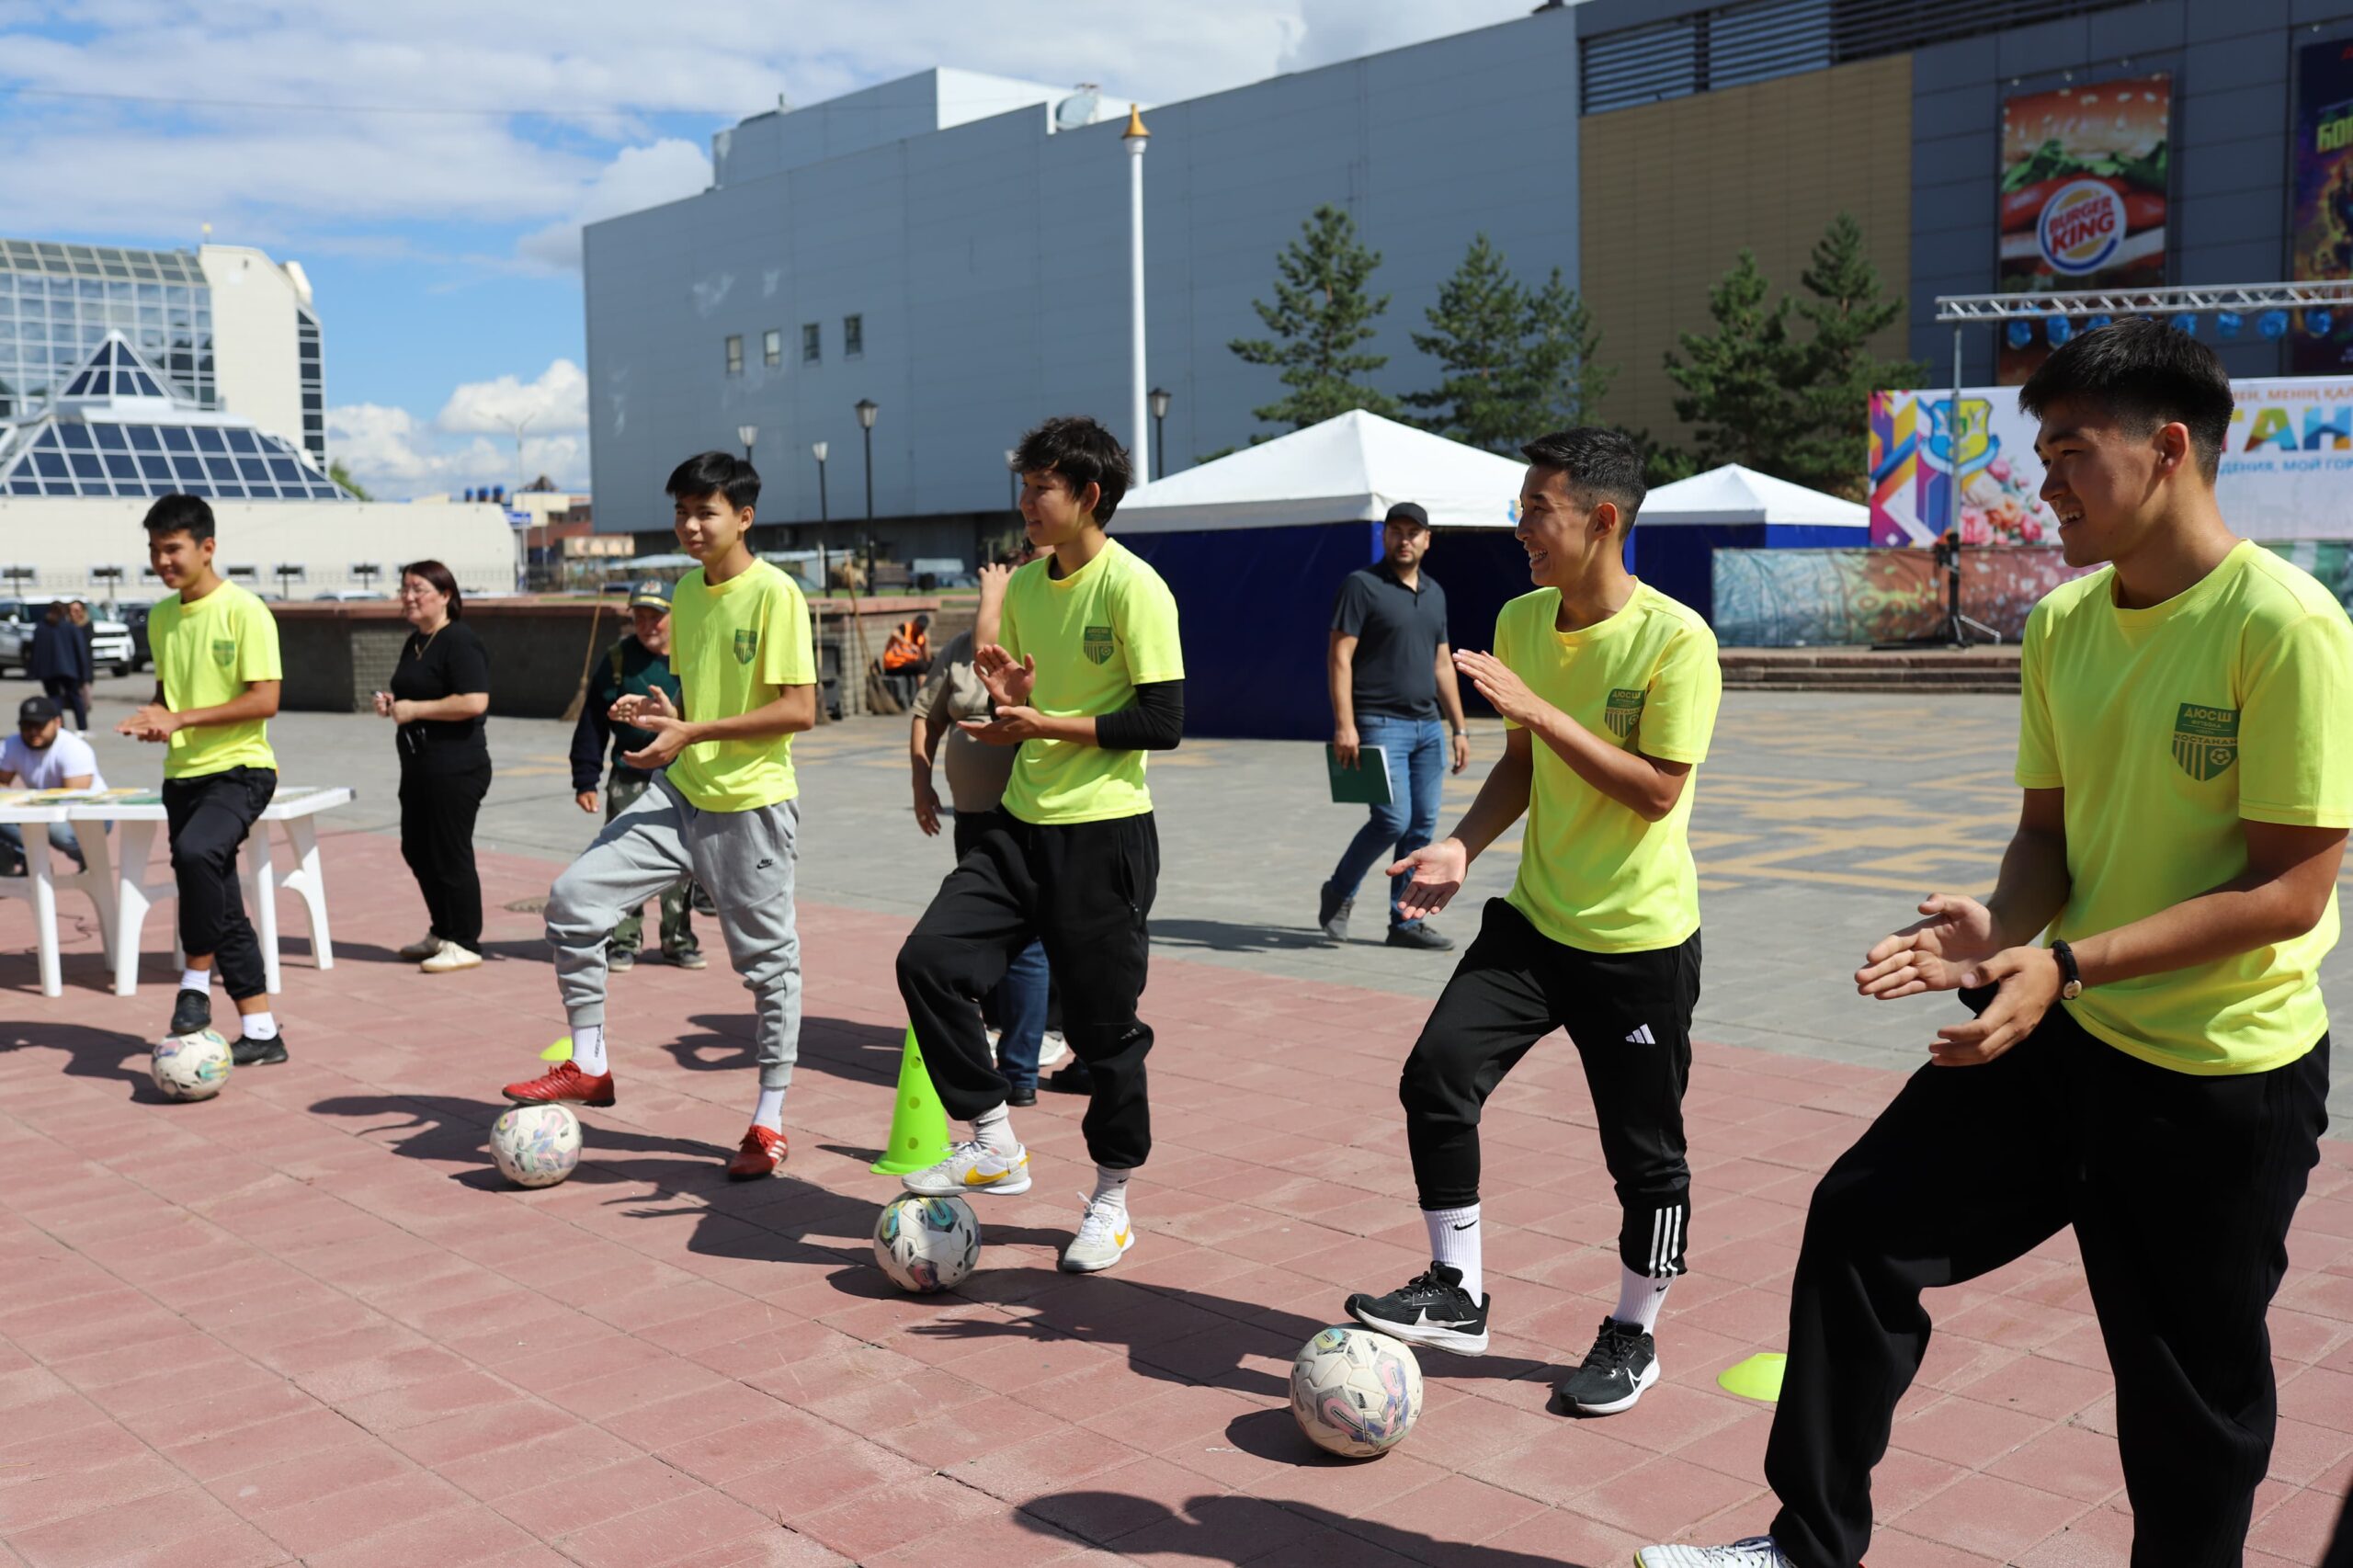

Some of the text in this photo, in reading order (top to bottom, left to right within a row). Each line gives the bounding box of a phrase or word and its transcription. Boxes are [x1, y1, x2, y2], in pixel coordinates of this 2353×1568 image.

[2049, 195, 2112, 236] BURGER
[2051, 212, 2116, 257] KING
[2283, 457, 2321, 472] МОЙ
[2184, 708, 2232, 722] ДЮСШ
